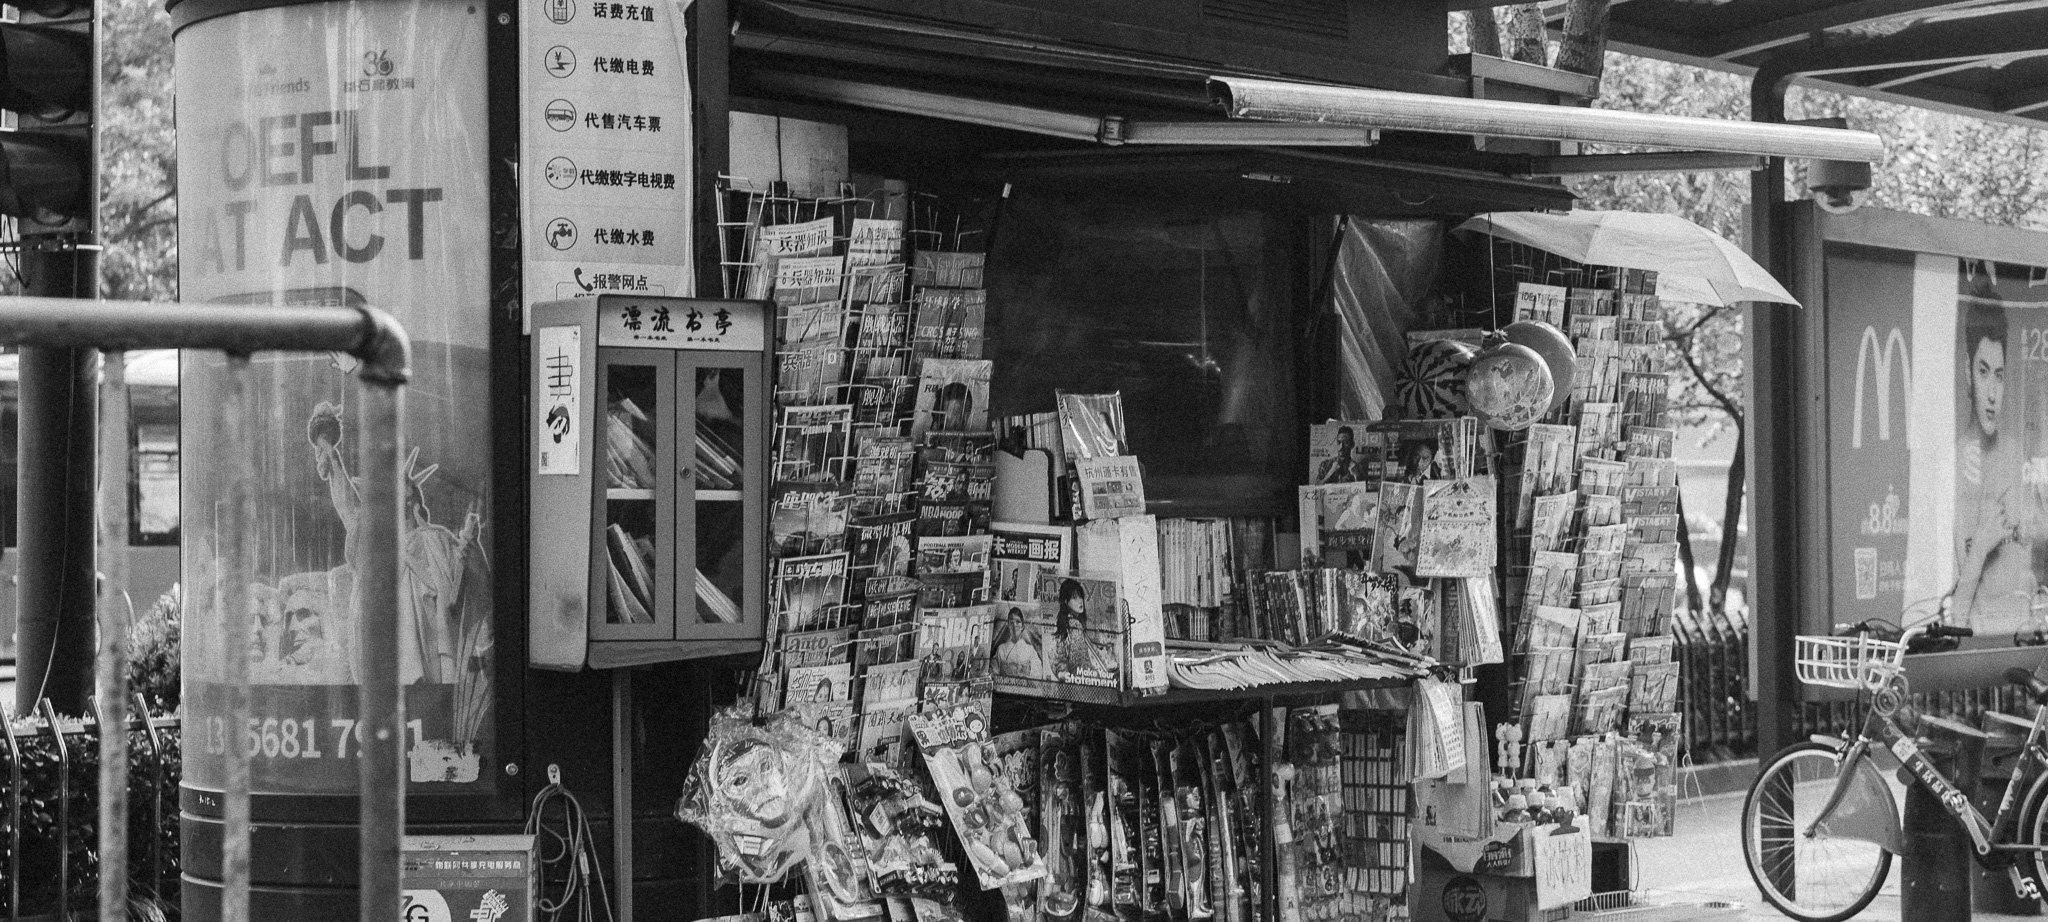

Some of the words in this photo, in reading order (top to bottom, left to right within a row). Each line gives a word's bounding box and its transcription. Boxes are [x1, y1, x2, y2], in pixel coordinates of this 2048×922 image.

[593, 2, 655, 22] 话费充值
[593, 57, 655, 76] 代缴电费
[585, 112, 661, 132] 代售汽车票
[580, 169, 675, 190] 代缴数字电视费
[279, 187, 443, 267] ACT
[594, 228, 655, 246] 代缴水费
[593, 273, 649, 291] 报警网点
[621, 305, 733, 336] 漂流书亭
[1356, 446, 1382, 455] LEON
[789, 636, 829, 651] auto
[1064, 672, 1118, 688] Statement
[1076, 666, 1098, 680] Make
[1099, 670, 1115, 680] Your
[248, 716, 322, 759] 5681
[331, 718, 423, 759] 71
[435, 860, 521, 870] 物联网共享充电服务商
